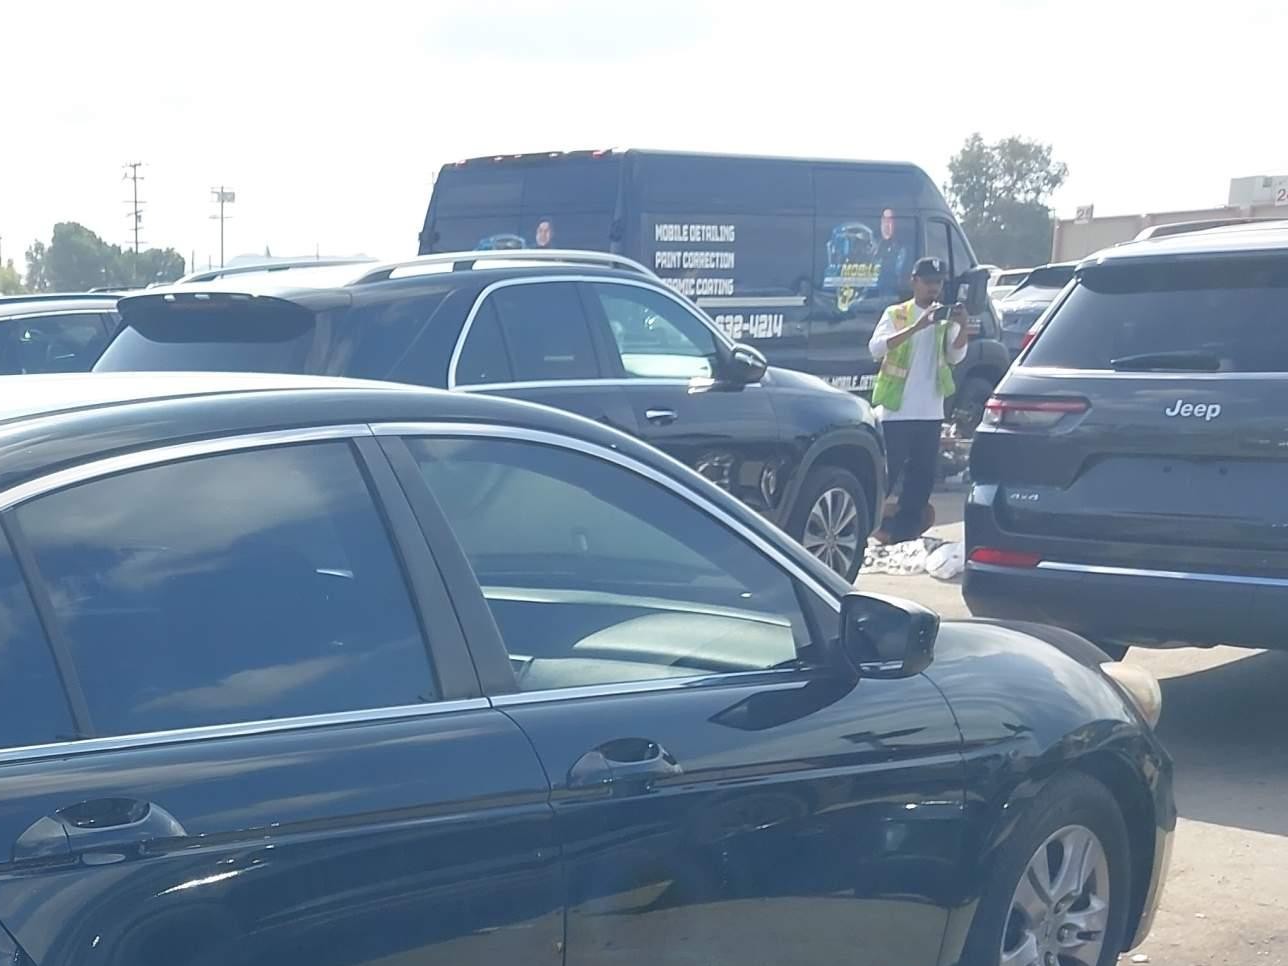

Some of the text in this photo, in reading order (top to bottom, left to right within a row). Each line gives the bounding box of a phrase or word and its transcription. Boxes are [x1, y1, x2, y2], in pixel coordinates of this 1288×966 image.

[1277, 188, 1288, 201] 2
[655, 224, 735, 241] MOBILE DETAILING
[655, 251, 735, 269] PAINT CORRECTION
[696, 278, 734, 295] COATING
[1165, 400, 1221, 421] Jeep
